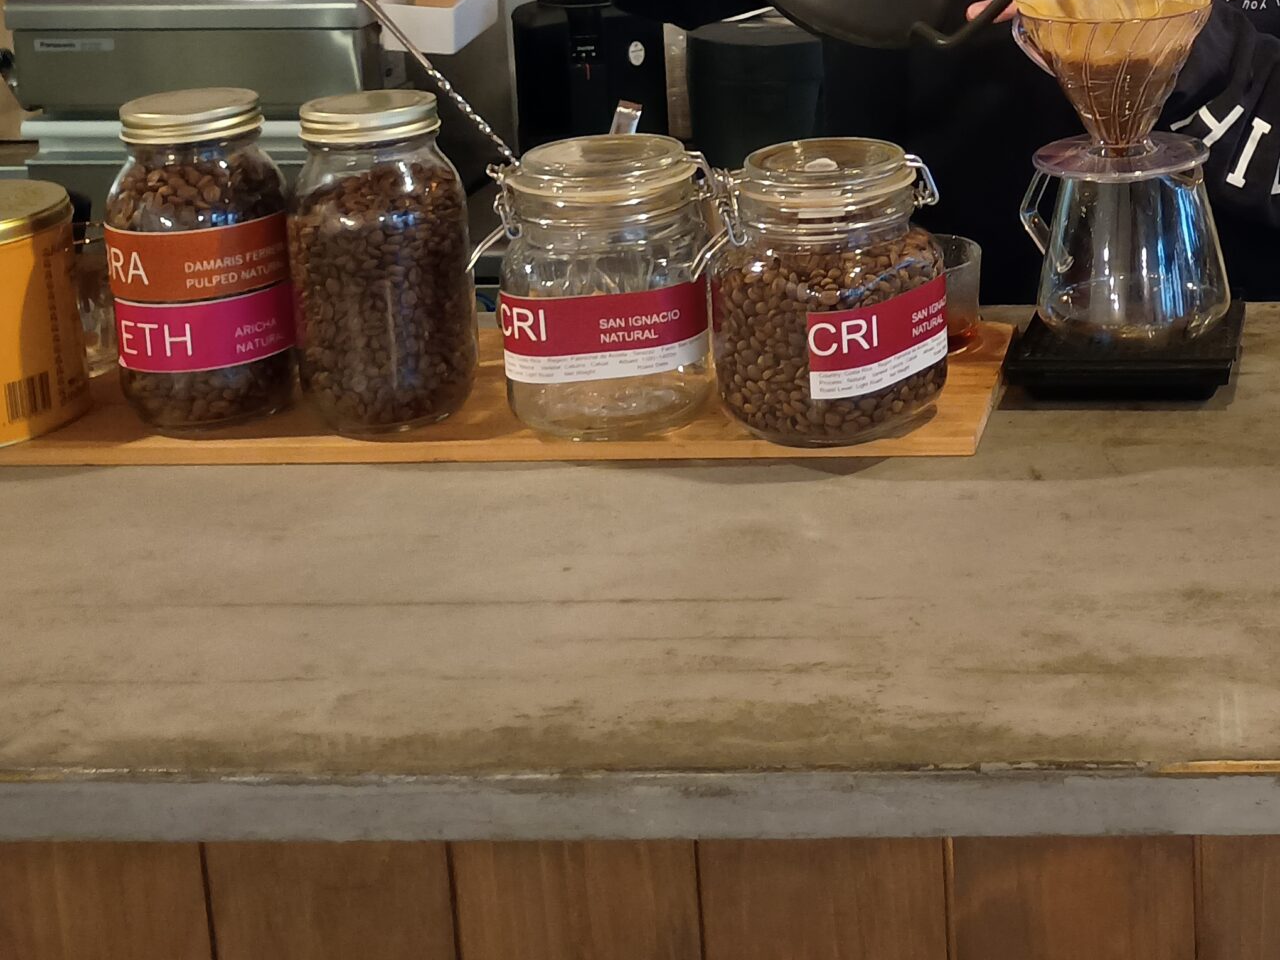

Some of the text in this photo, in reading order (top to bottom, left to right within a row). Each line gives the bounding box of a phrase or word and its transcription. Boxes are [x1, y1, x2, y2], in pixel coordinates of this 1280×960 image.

[105, 243, 148, 286] RA
[185, 254, 243, 273] DAMARIS
[186, 272, 238, 289] PULPED
[500, 303, 547, 341] CRI
[599, 309, 680, 330] SAN IGNACIO
[911, 308, 928, 323] SAN
[912, 314, 944, 338] NATURAL
[235, 317, 277, 338] ARICHA
[600, 329, 658, 344] NATURAL
[808, 315, 878, 356] CRI
[121, 320, 192, 357] ETH
